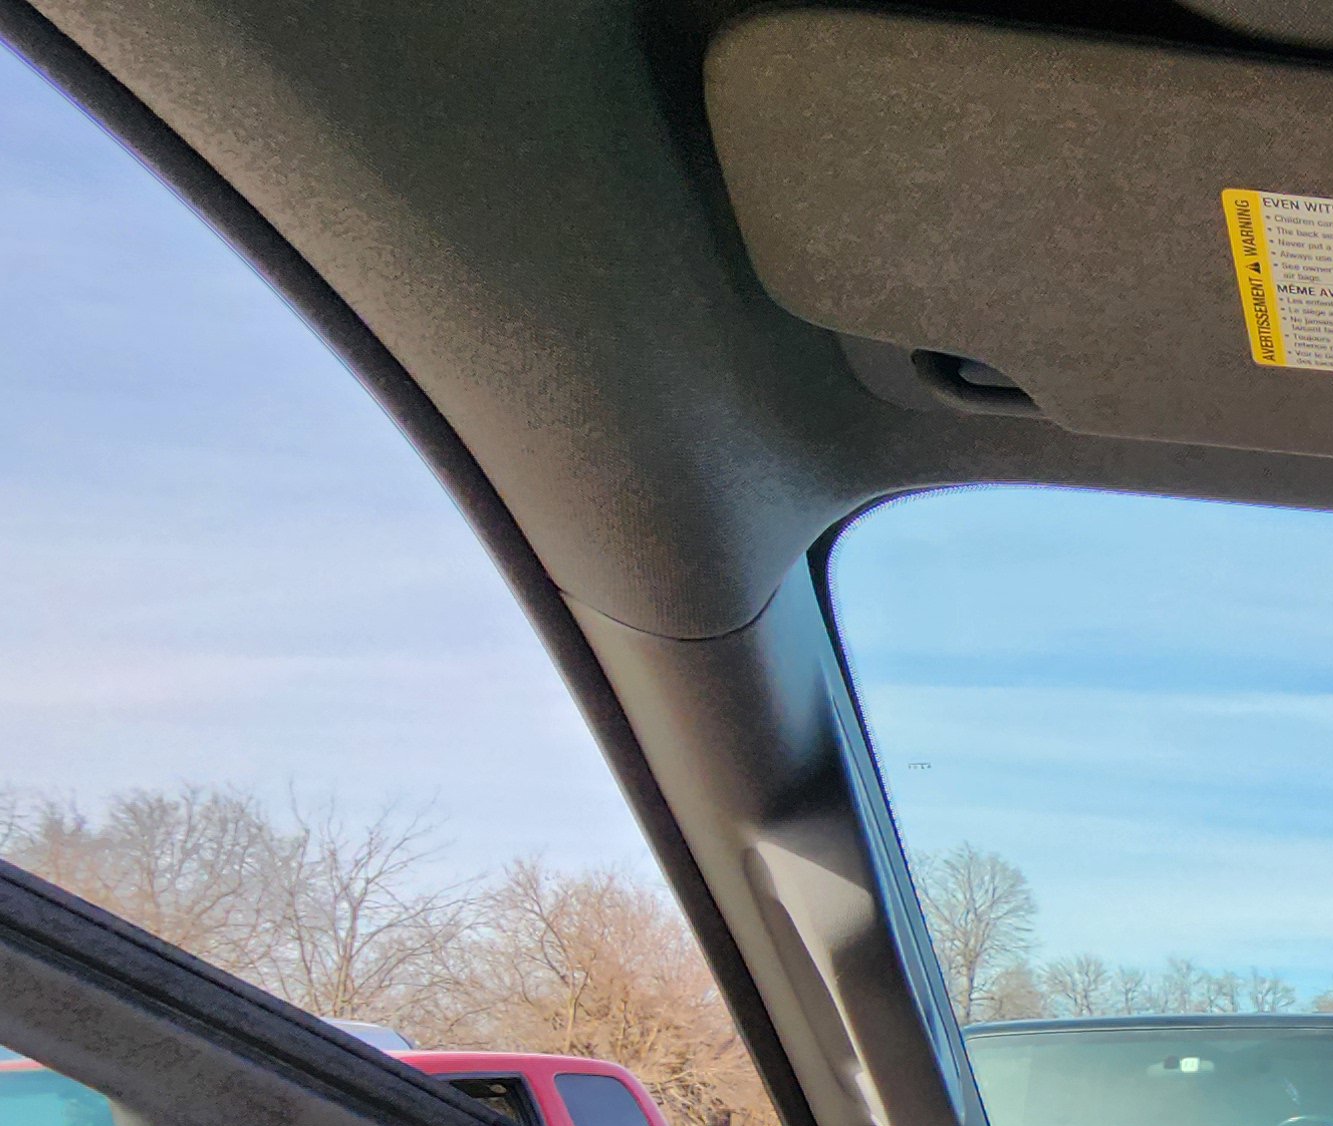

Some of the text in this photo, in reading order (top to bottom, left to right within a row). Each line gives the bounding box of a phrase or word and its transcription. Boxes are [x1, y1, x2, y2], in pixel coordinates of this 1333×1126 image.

[1263, 198, 1299, 210] EVEN
[1235, 200, 1276, 362] AVERTISSEMENT WARNING
